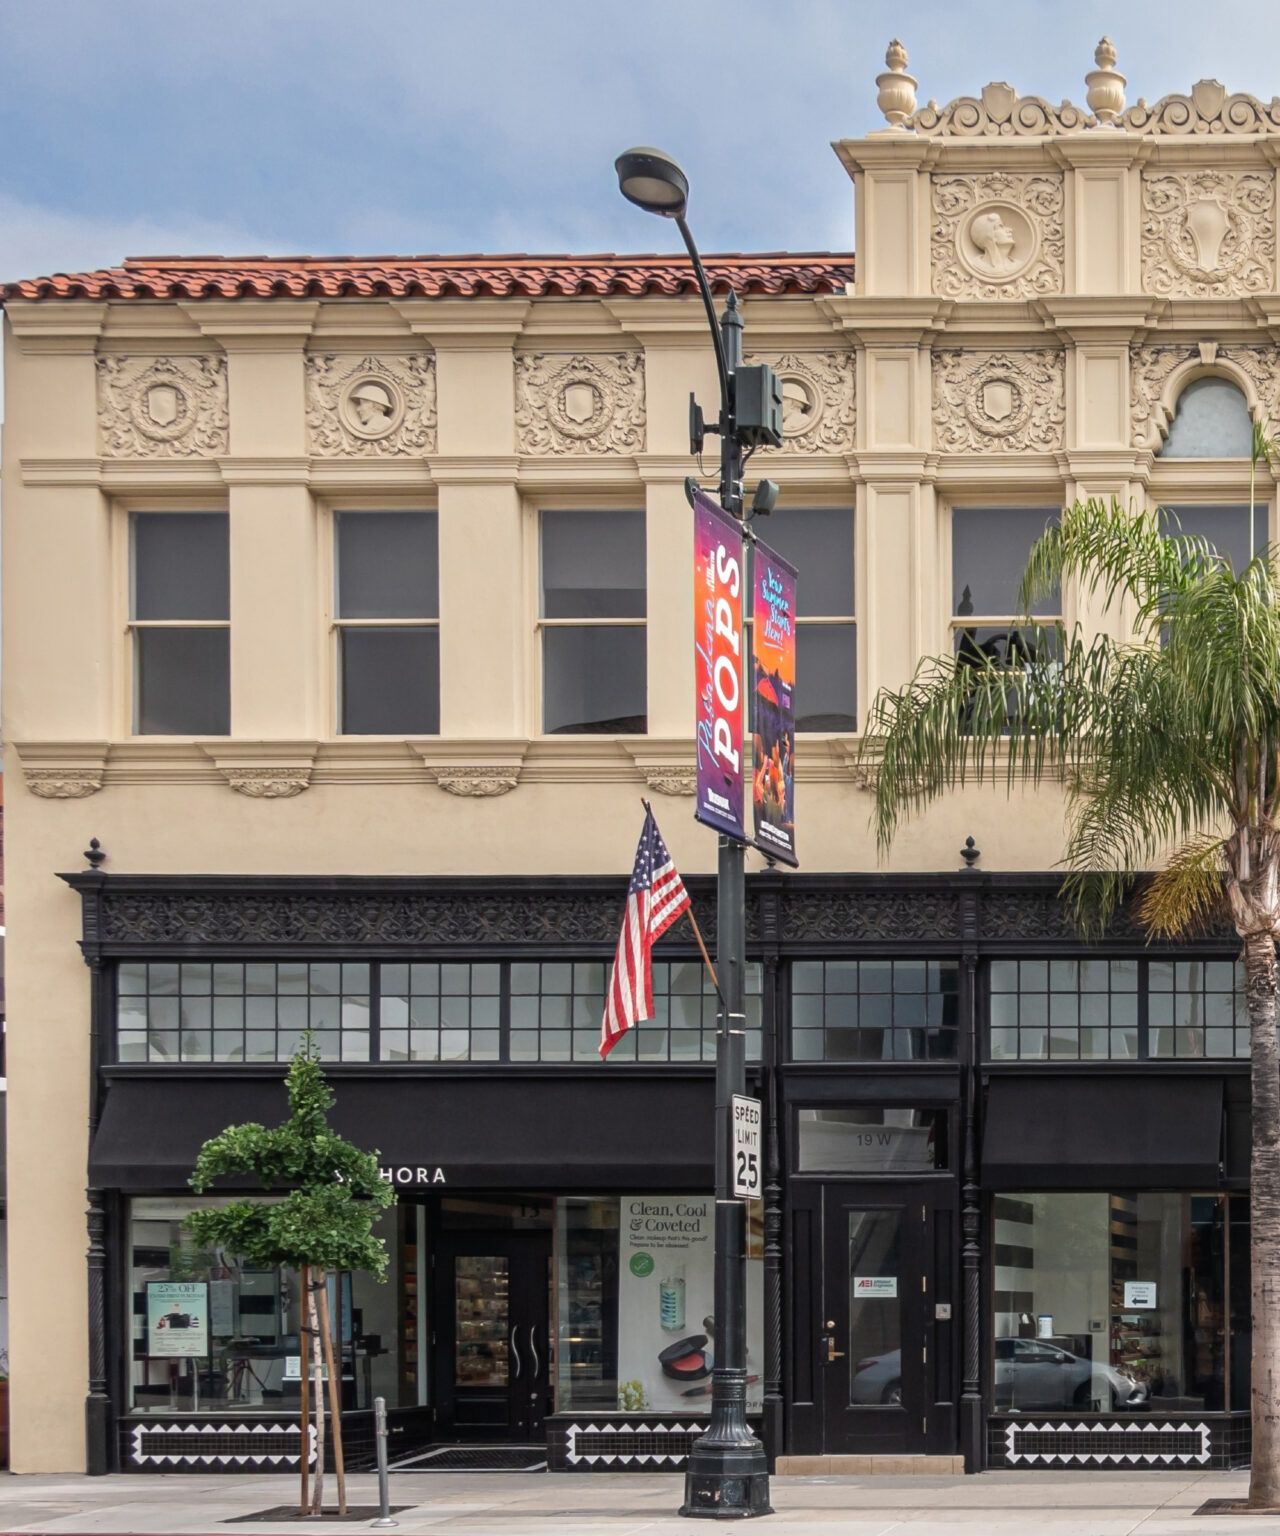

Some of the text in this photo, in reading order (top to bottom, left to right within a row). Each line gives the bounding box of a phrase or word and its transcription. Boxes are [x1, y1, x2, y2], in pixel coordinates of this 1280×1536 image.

[713, 544, 740, 774] POPS
[696, 598, 720, 770] Pasadena
[735, 1105, 760, 1125] SPEED
[737, 1130, 758, 1147] LIMIT
[856, 1133, 893, 1147] 19 W
[334, 1167, 446, 1184] SHORA
[736, 1150, 758, 1189] 25
[629, 1201, 707, 1218] Clean, Cool
[629, 1218, 700, 1232] & Coveted
